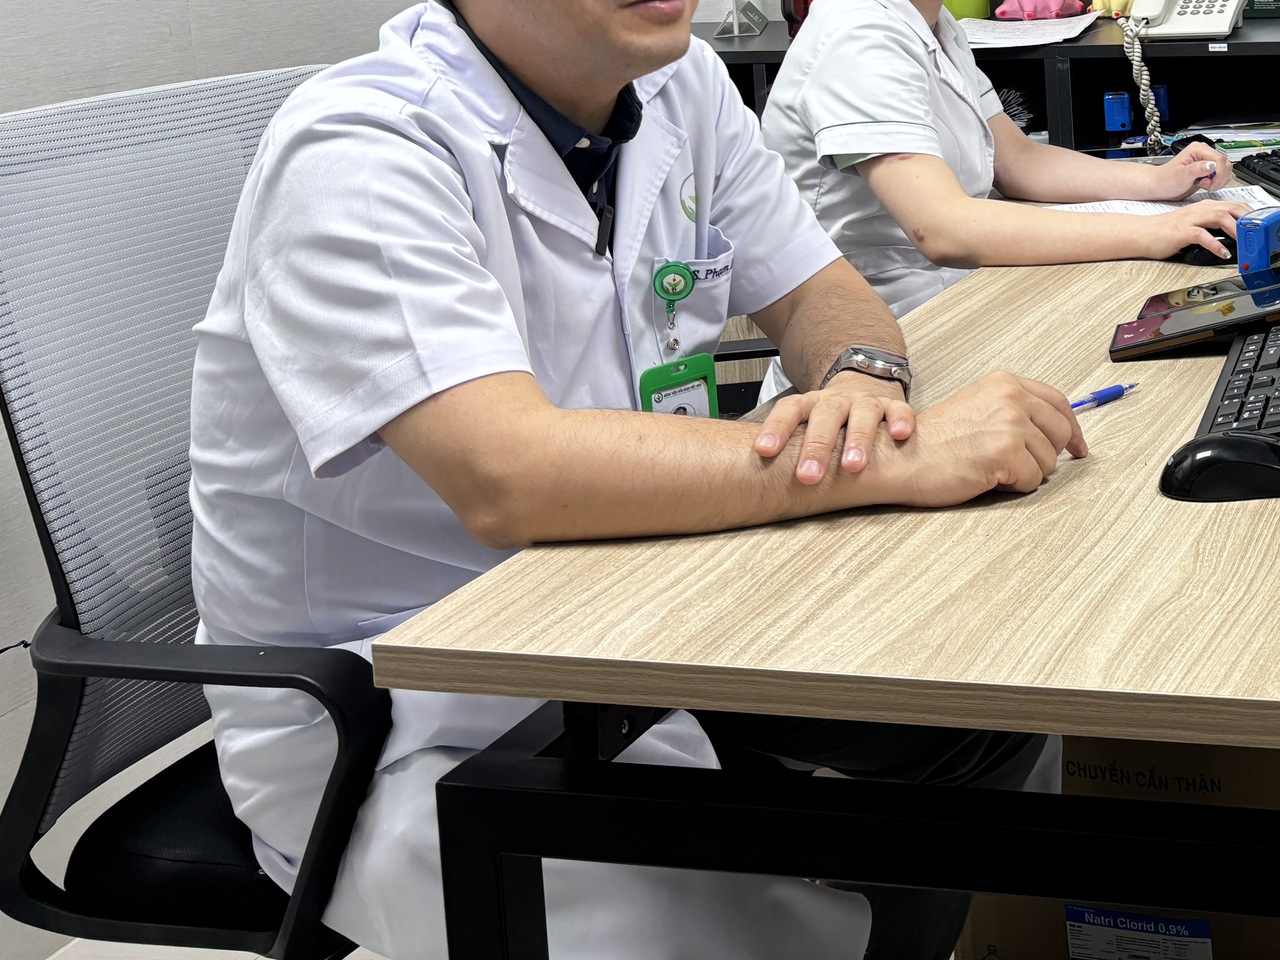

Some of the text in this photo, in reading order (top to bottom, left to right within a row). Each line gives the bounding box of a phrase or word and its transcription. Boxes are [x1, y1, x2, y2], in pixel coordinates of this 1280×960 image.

[1066, 760, 1222, 795] CHUYỂN CẨN THẬN
[1084, 912, 1114, 927] Natri
[1117, 918, 1154, 932] Clorid
